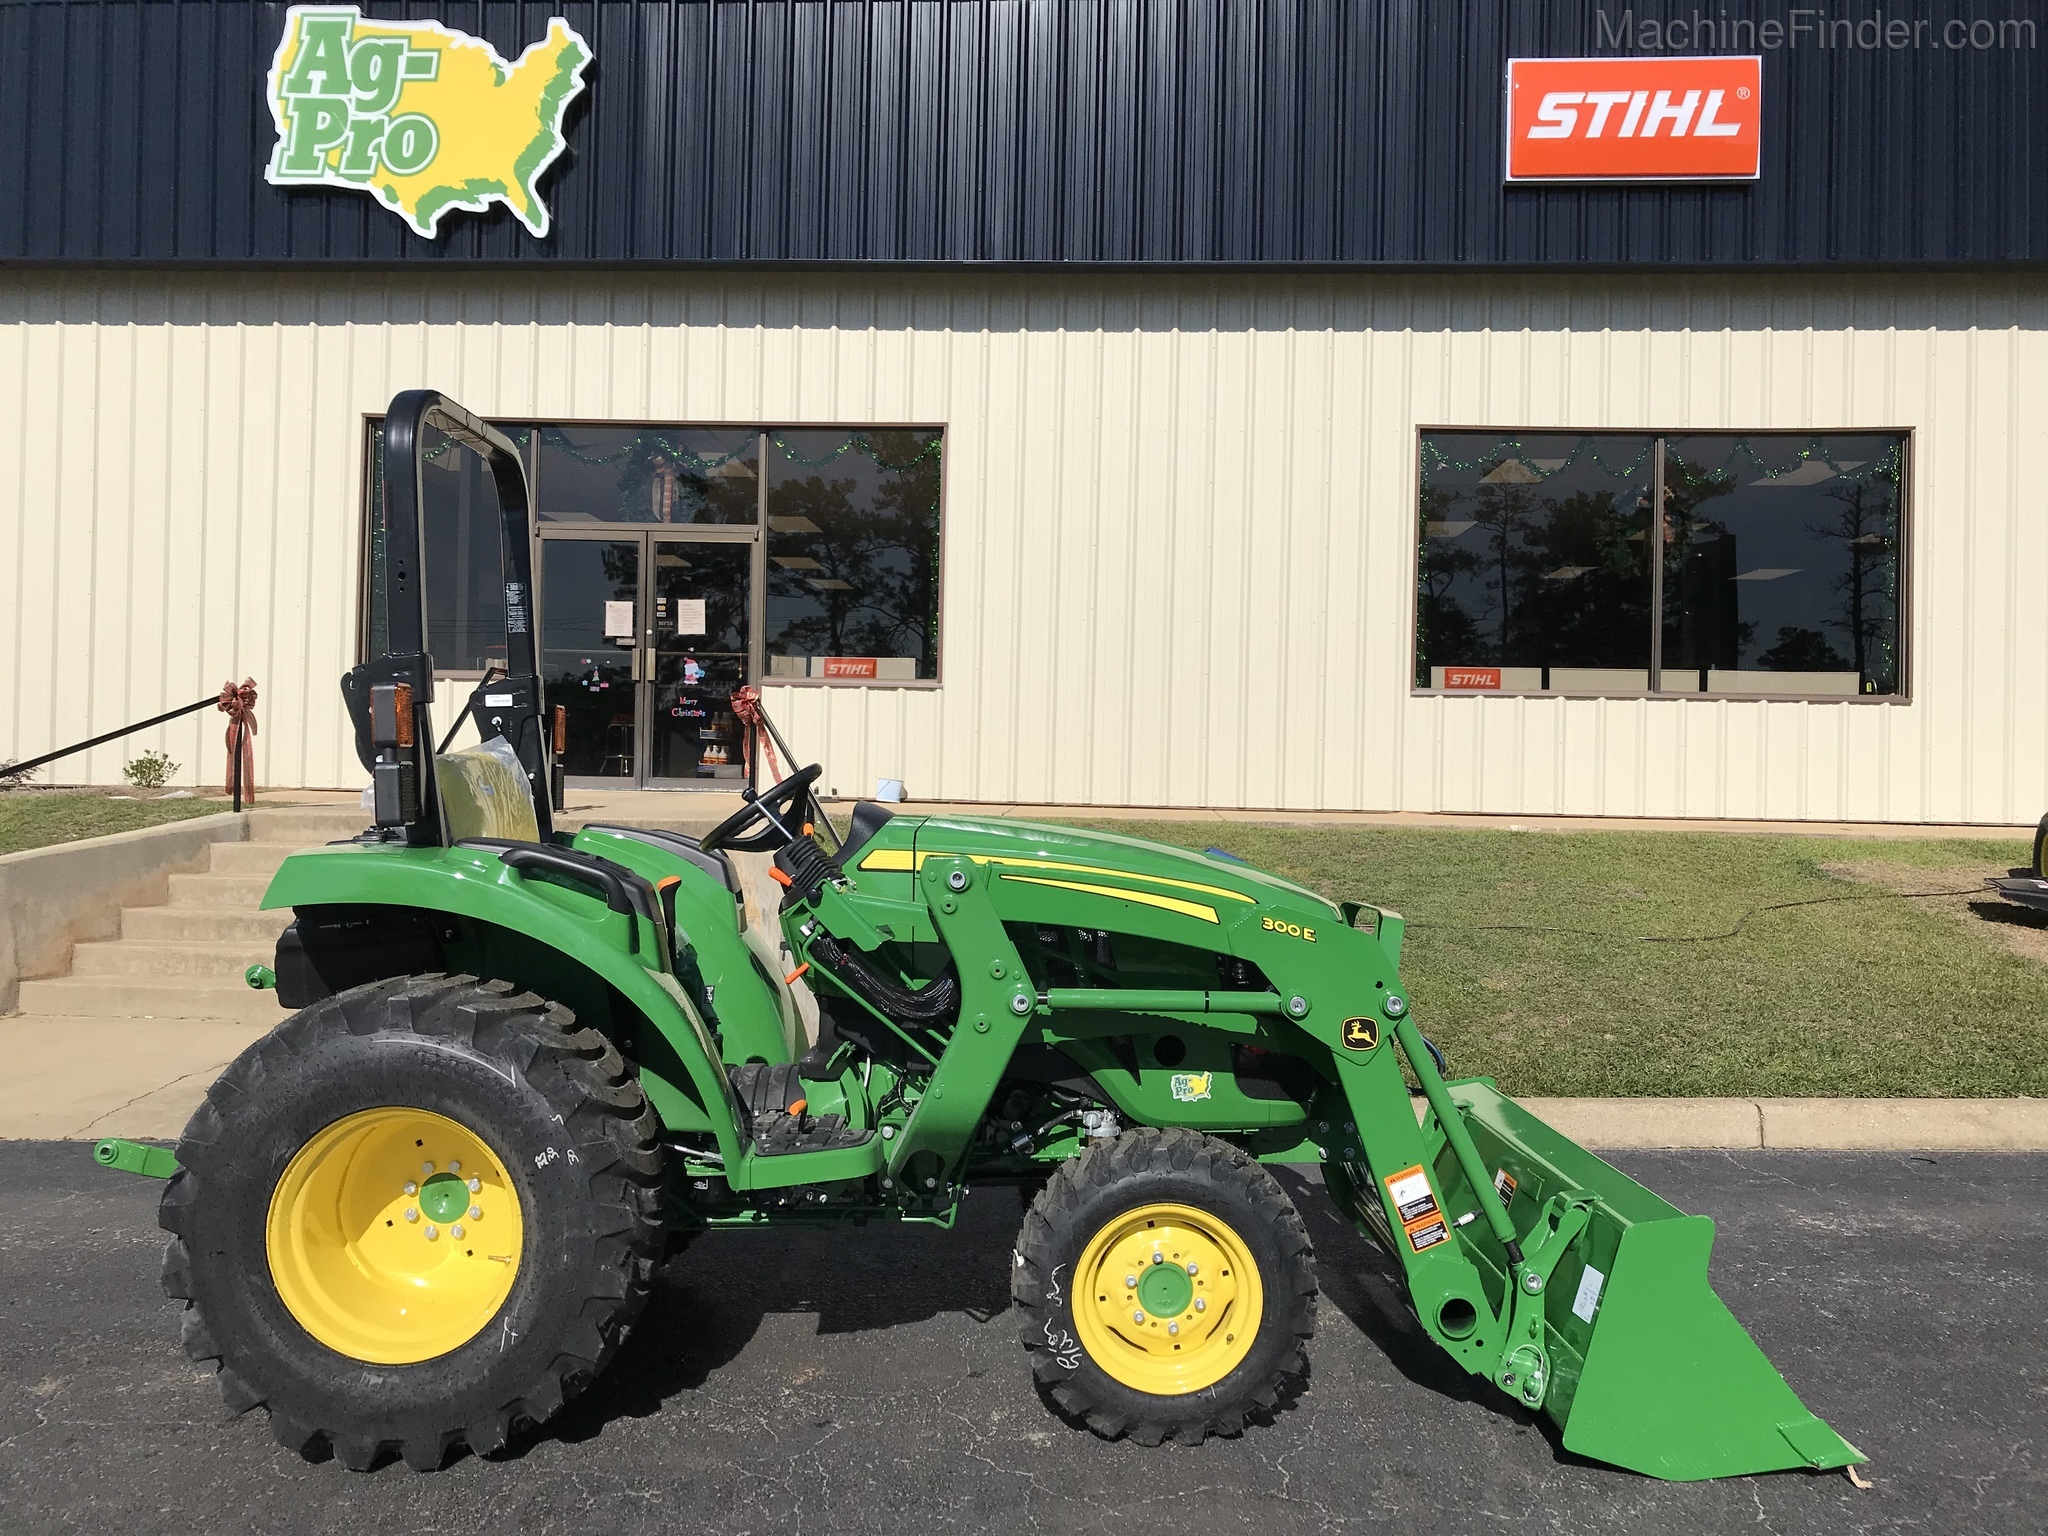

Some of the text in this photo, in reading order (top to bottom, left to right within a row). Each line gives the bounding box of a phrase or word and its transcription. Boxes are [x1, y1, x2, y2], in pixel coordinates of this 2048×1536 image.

[281, 16, 439, 114] Ag-
[280, 97, 438, 175] Pro
[827, 664, 870, 675] STIHL
[1450, 674, 1495, 685] STIHL
[679, 696, 698, 705] Merry
[671, 707, 706, 717] Christmas
[1175, 1087, 1194, 1096] Pro
[1395, 1168, 1420, 1181] WARNING
[1416, 1216, 1440, 1229] WARNING
